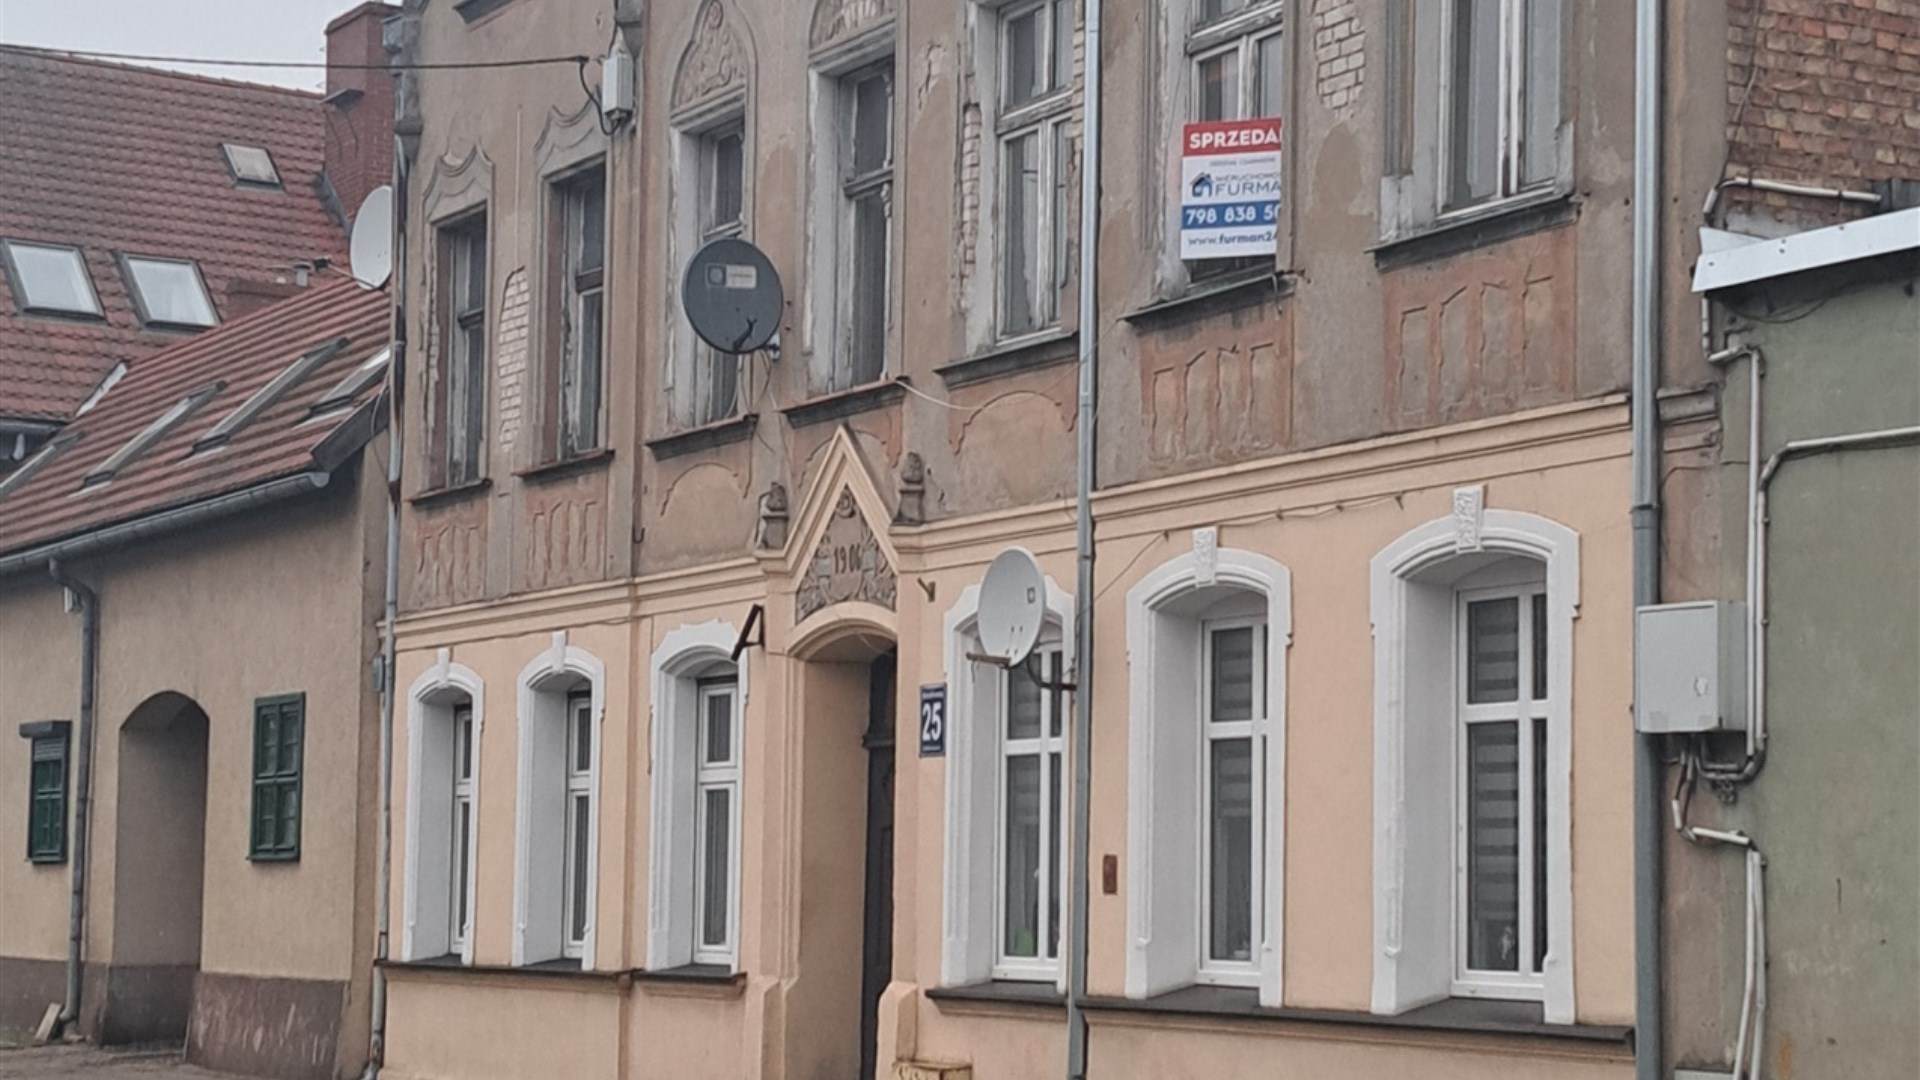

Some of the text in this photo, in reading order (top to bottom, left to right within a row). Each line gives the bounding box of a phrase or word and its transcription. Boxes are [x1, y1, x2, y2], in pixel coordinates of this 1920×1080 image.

[1189, 126, 1282, 149] SPRZEDA
[1185, 207, 1217, 225] 798
[1224, 205, 1256, 223] 838
[922, 701, 942, 742] 25
